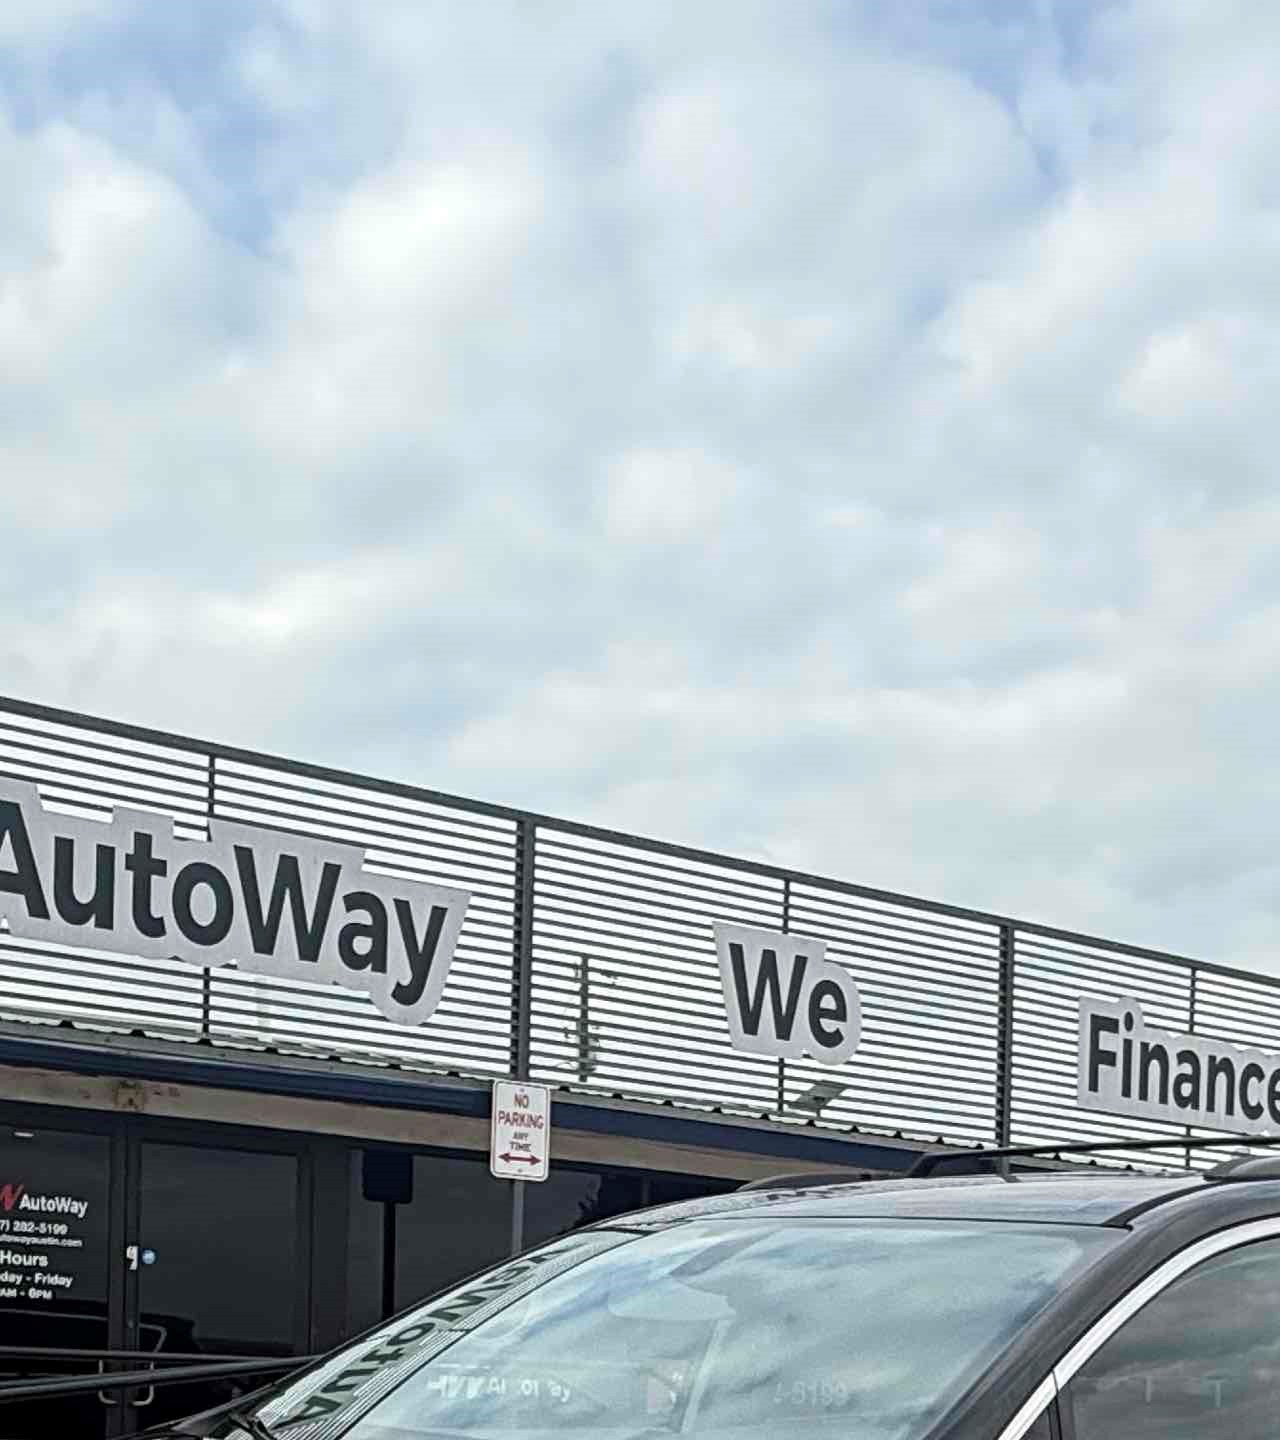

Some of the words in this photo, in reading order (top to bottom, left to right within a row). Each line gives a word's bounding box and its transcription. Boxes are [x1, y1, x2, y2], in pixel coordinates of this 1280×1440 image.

[728, 942, 848, 1049] We
[513, 1092, 529, 1109] NO
[498, 1110, 544, 1130] PARKING
[512, 1131, 529, 1141] ANY
[509, 1141, 532, 1152] TIME
[19, 1193, 88, 1218] AutoWay
[13, 1220, 68, 1235] 282-5199
[0, 1249, 49, 1267] Hours
[34, 1272, 73, 1287] Friday
